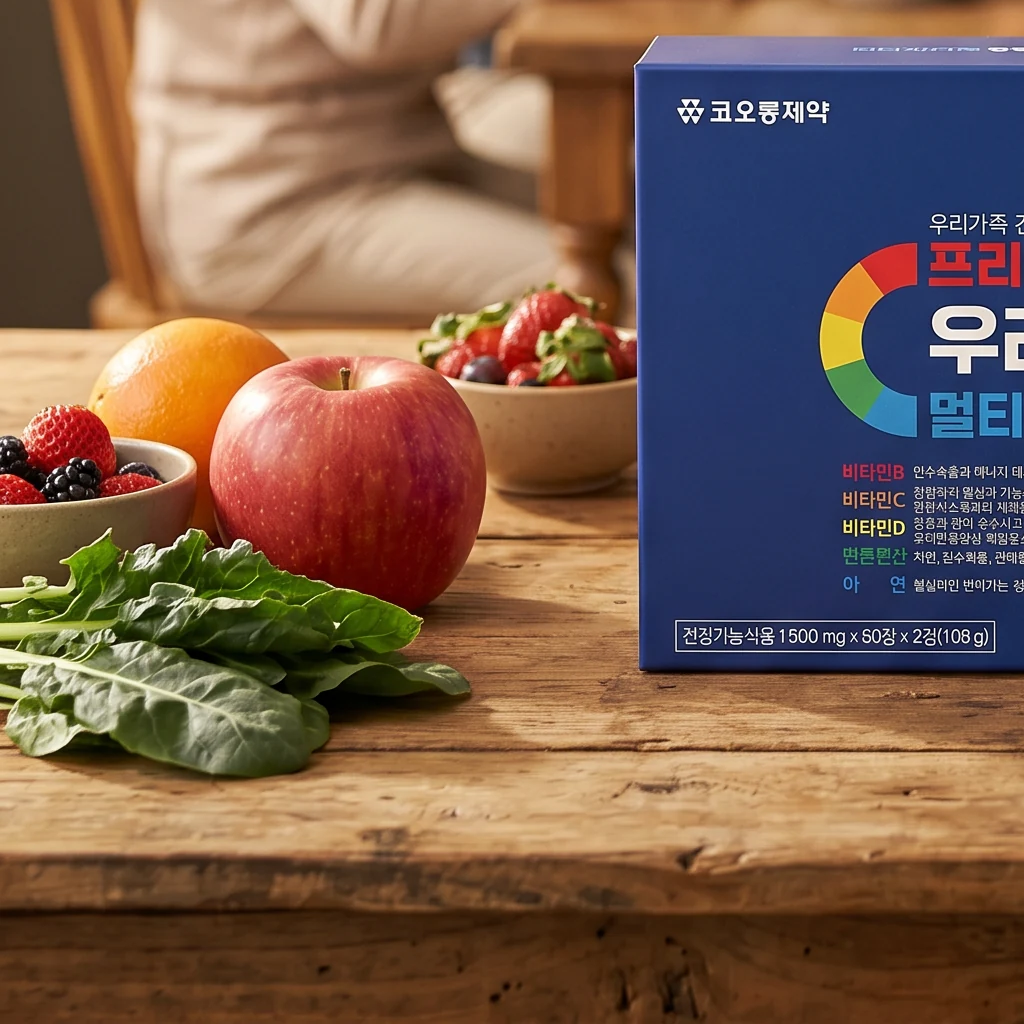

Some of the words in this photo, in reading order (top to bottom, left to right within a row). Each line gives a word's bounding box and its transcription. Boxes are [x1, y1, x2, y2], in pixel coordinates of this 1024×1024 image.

[930, 214, 1008, 235] 우리가족
[843, 464, 904, 481] 비타민B
[843, 491, 905, 509] 비타민C
[844, 519, 905, 537] 비타민D
[780, 629, 818, 643] 1500
[823, 632, 845, 647] mg
